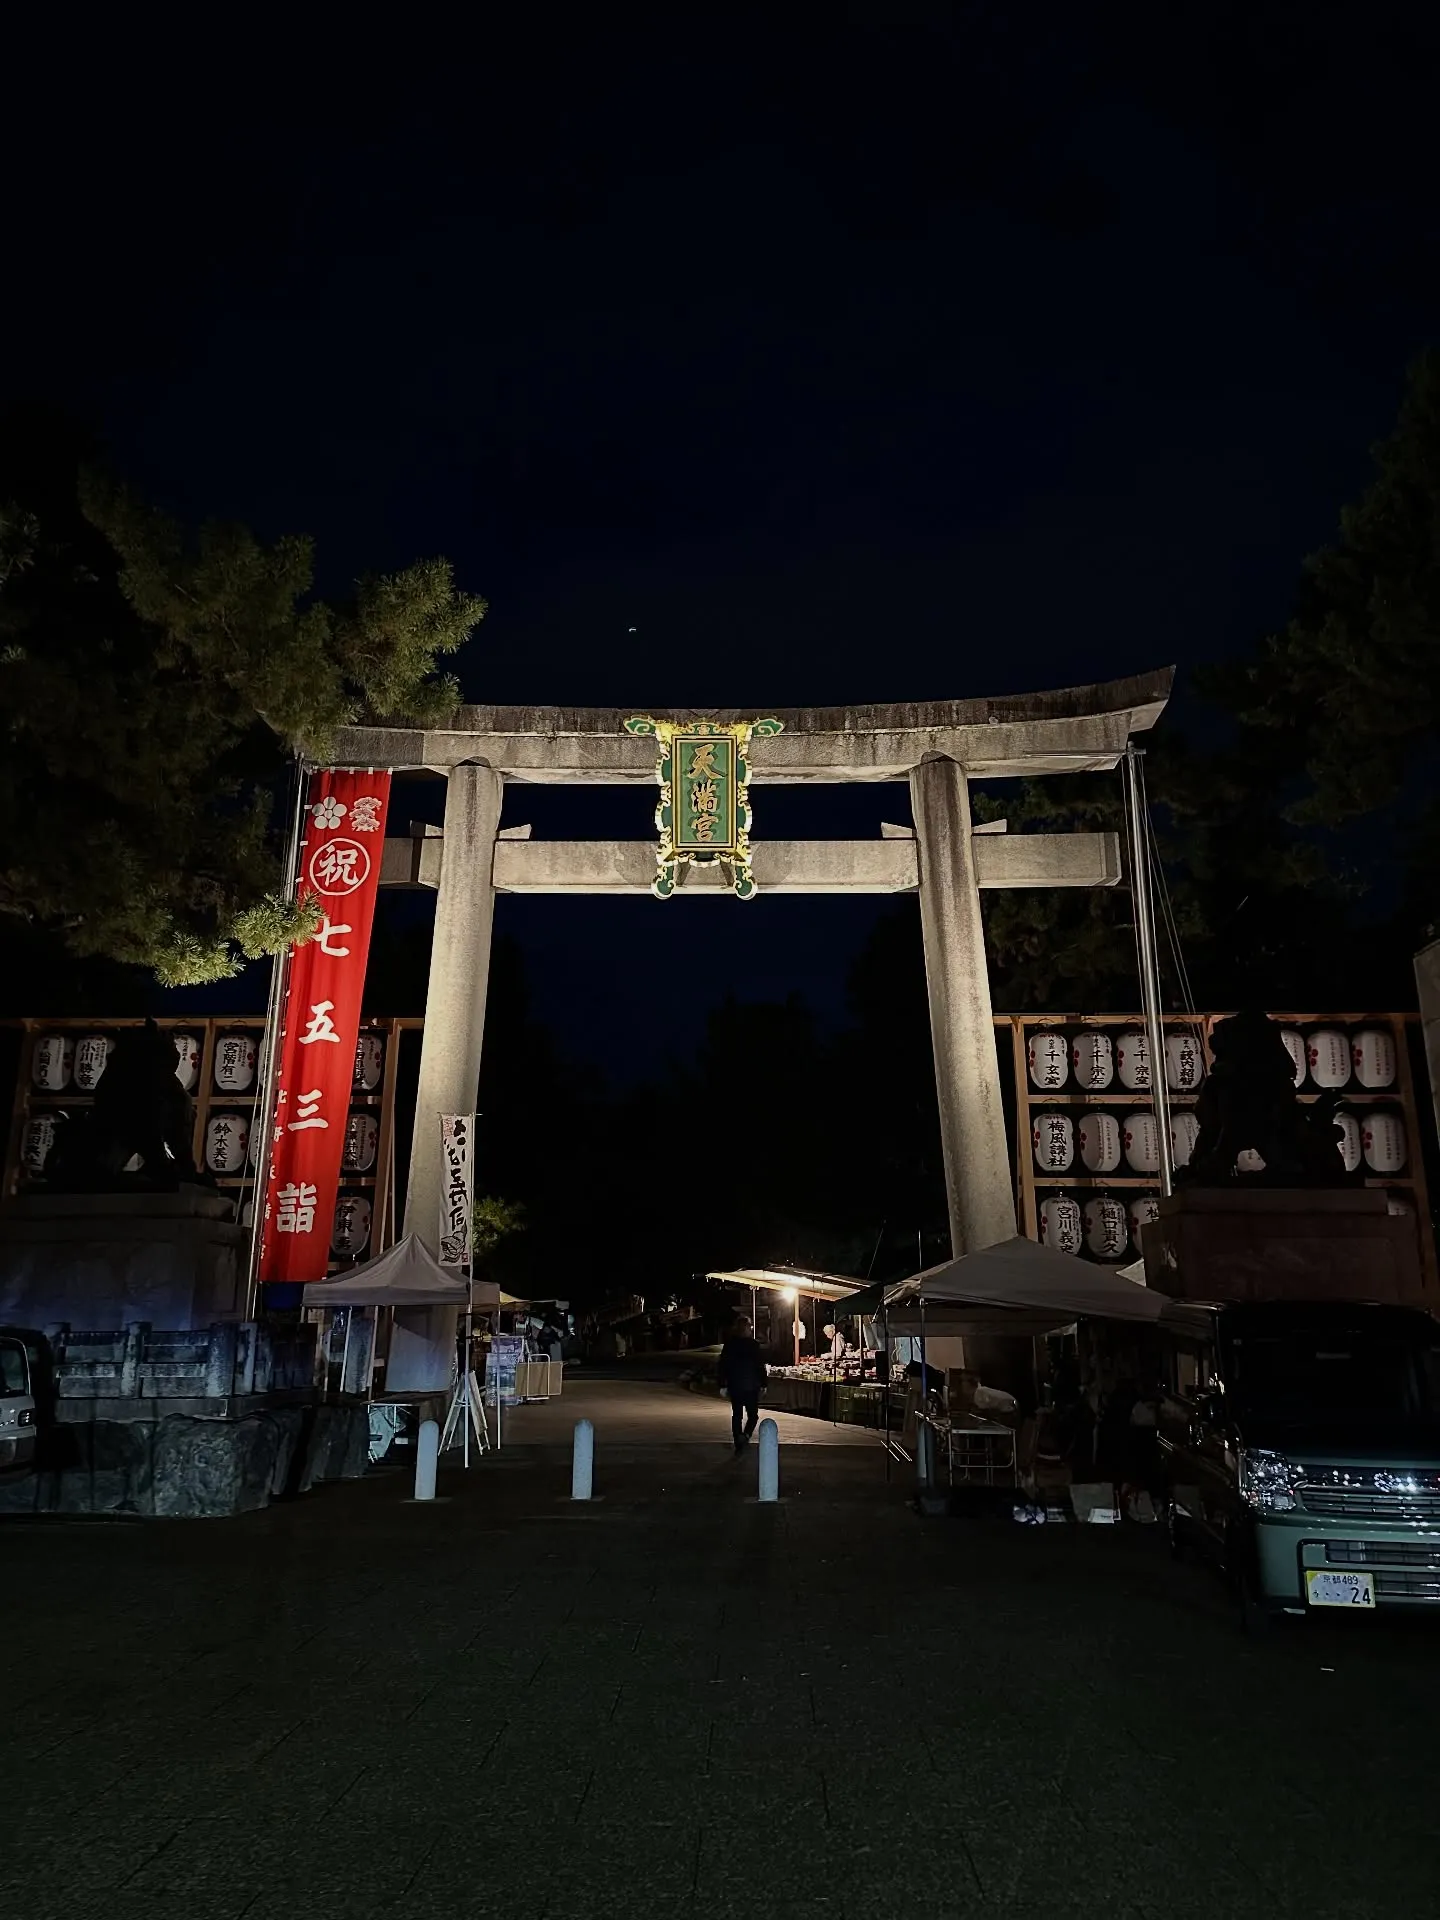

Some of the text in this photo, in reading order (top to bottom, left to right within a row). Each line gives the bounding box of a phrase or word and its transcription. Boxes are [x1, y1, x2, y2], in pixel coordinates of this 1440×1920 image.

[687, 743, 725, 842] 天満宮
[316, 845, 359, 887] 祝
[276, 917, 352, 1233] 七五三詣
[1088, 1050, 1106, 1085] 千宗左
[1133, 1050, 1150, 1085] 千宗室
[1047, 1121, 1067, 1167] 梅風講社
[1323, 1574, 1341, 1584] 京都
